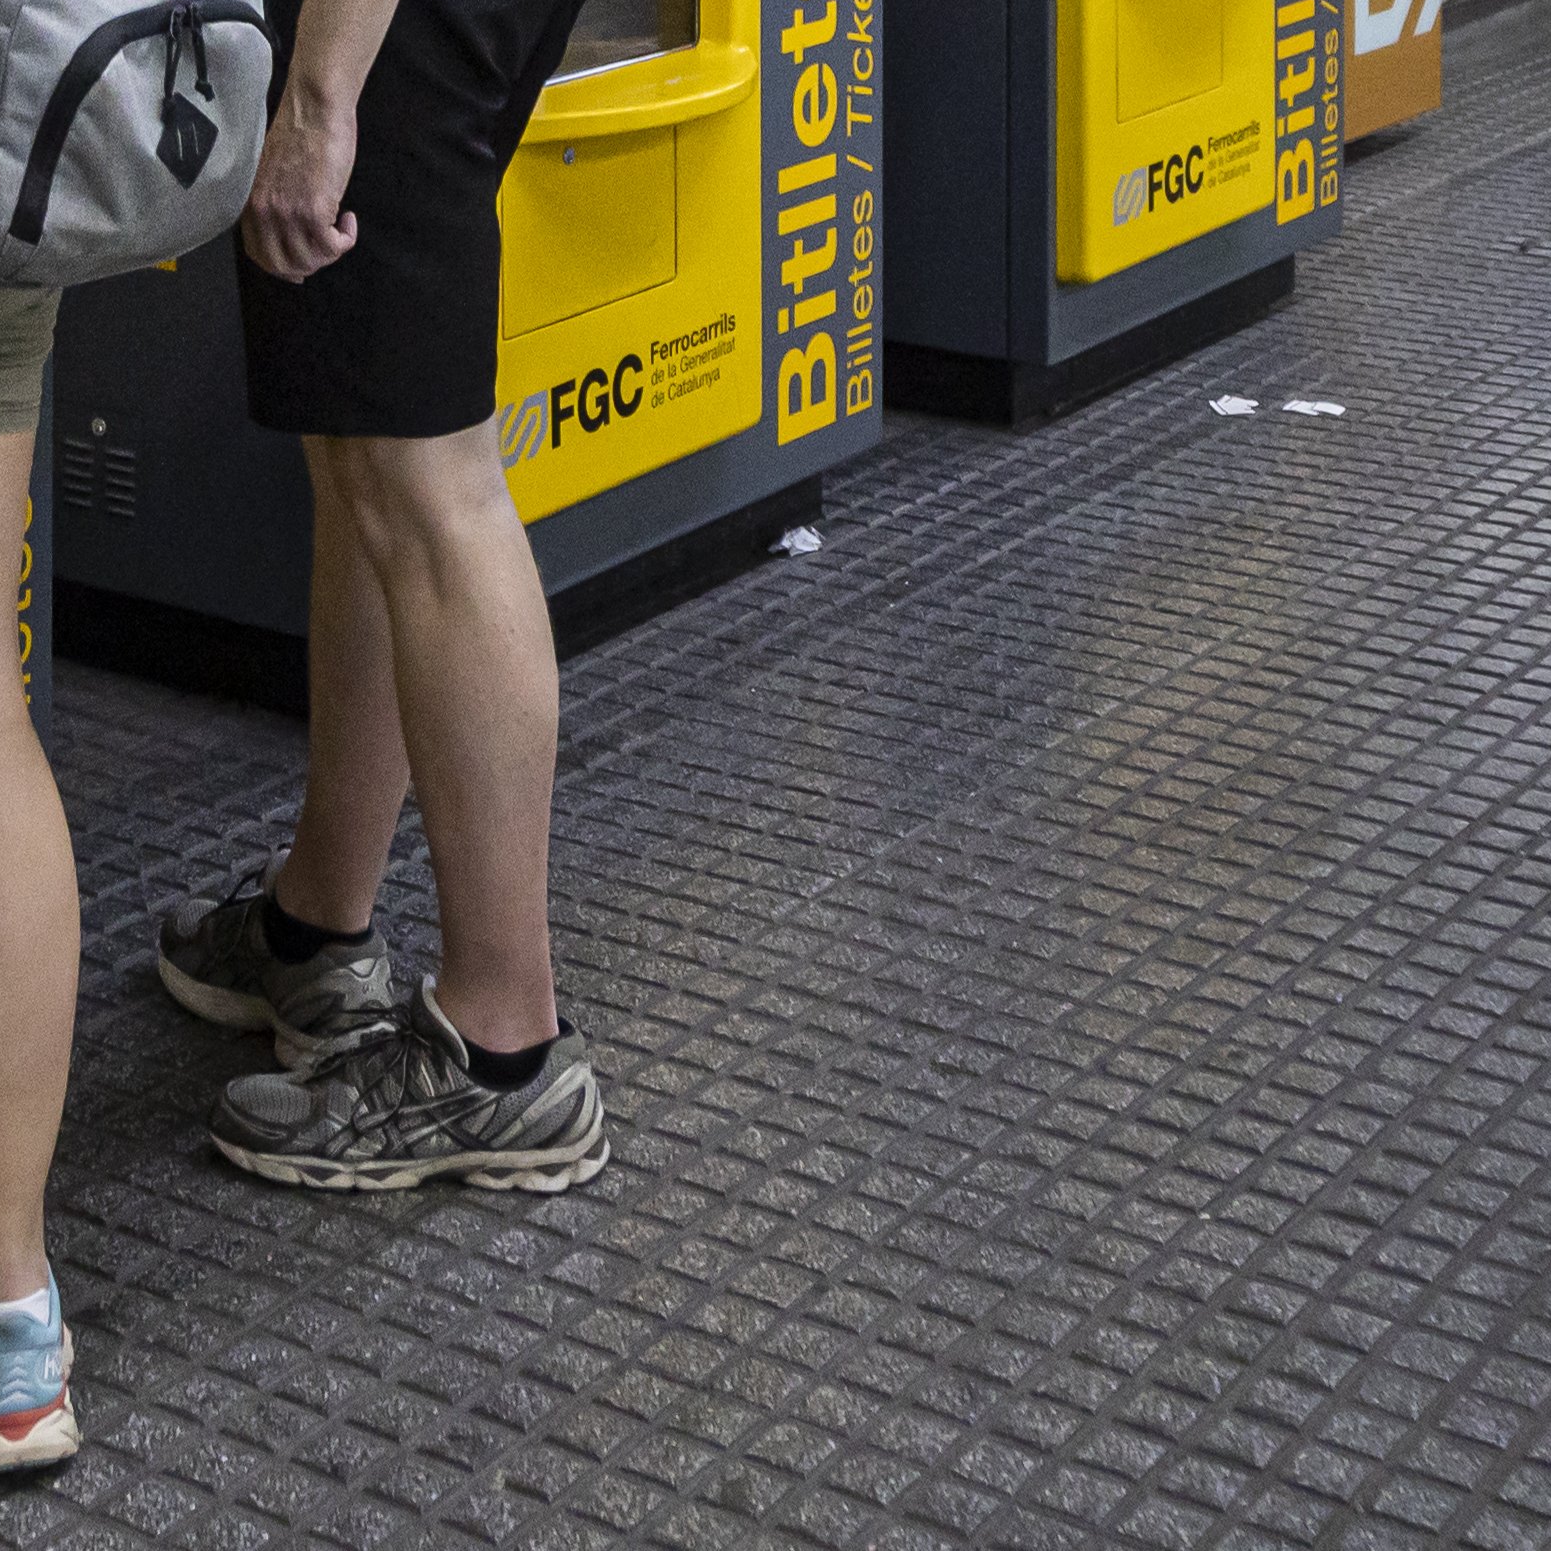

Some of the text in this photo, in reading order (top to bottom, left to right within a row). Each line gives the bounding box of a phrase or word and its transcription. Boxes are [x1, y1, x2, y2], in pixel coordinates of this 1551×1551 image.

[1320, 26, 1339, 208] Billetes
[847, 154, 875, 174] /
[1148, 145, 1204, 213] FGC
[846, 189, 875, 418] Billetes
[650, 312, 736, 365] Ferrocarrils
[650, 336, 736, 386] de la Generalitat
[551, 352, 645, 450] FGC
[650, 367, 721, 409] de Catalunya
